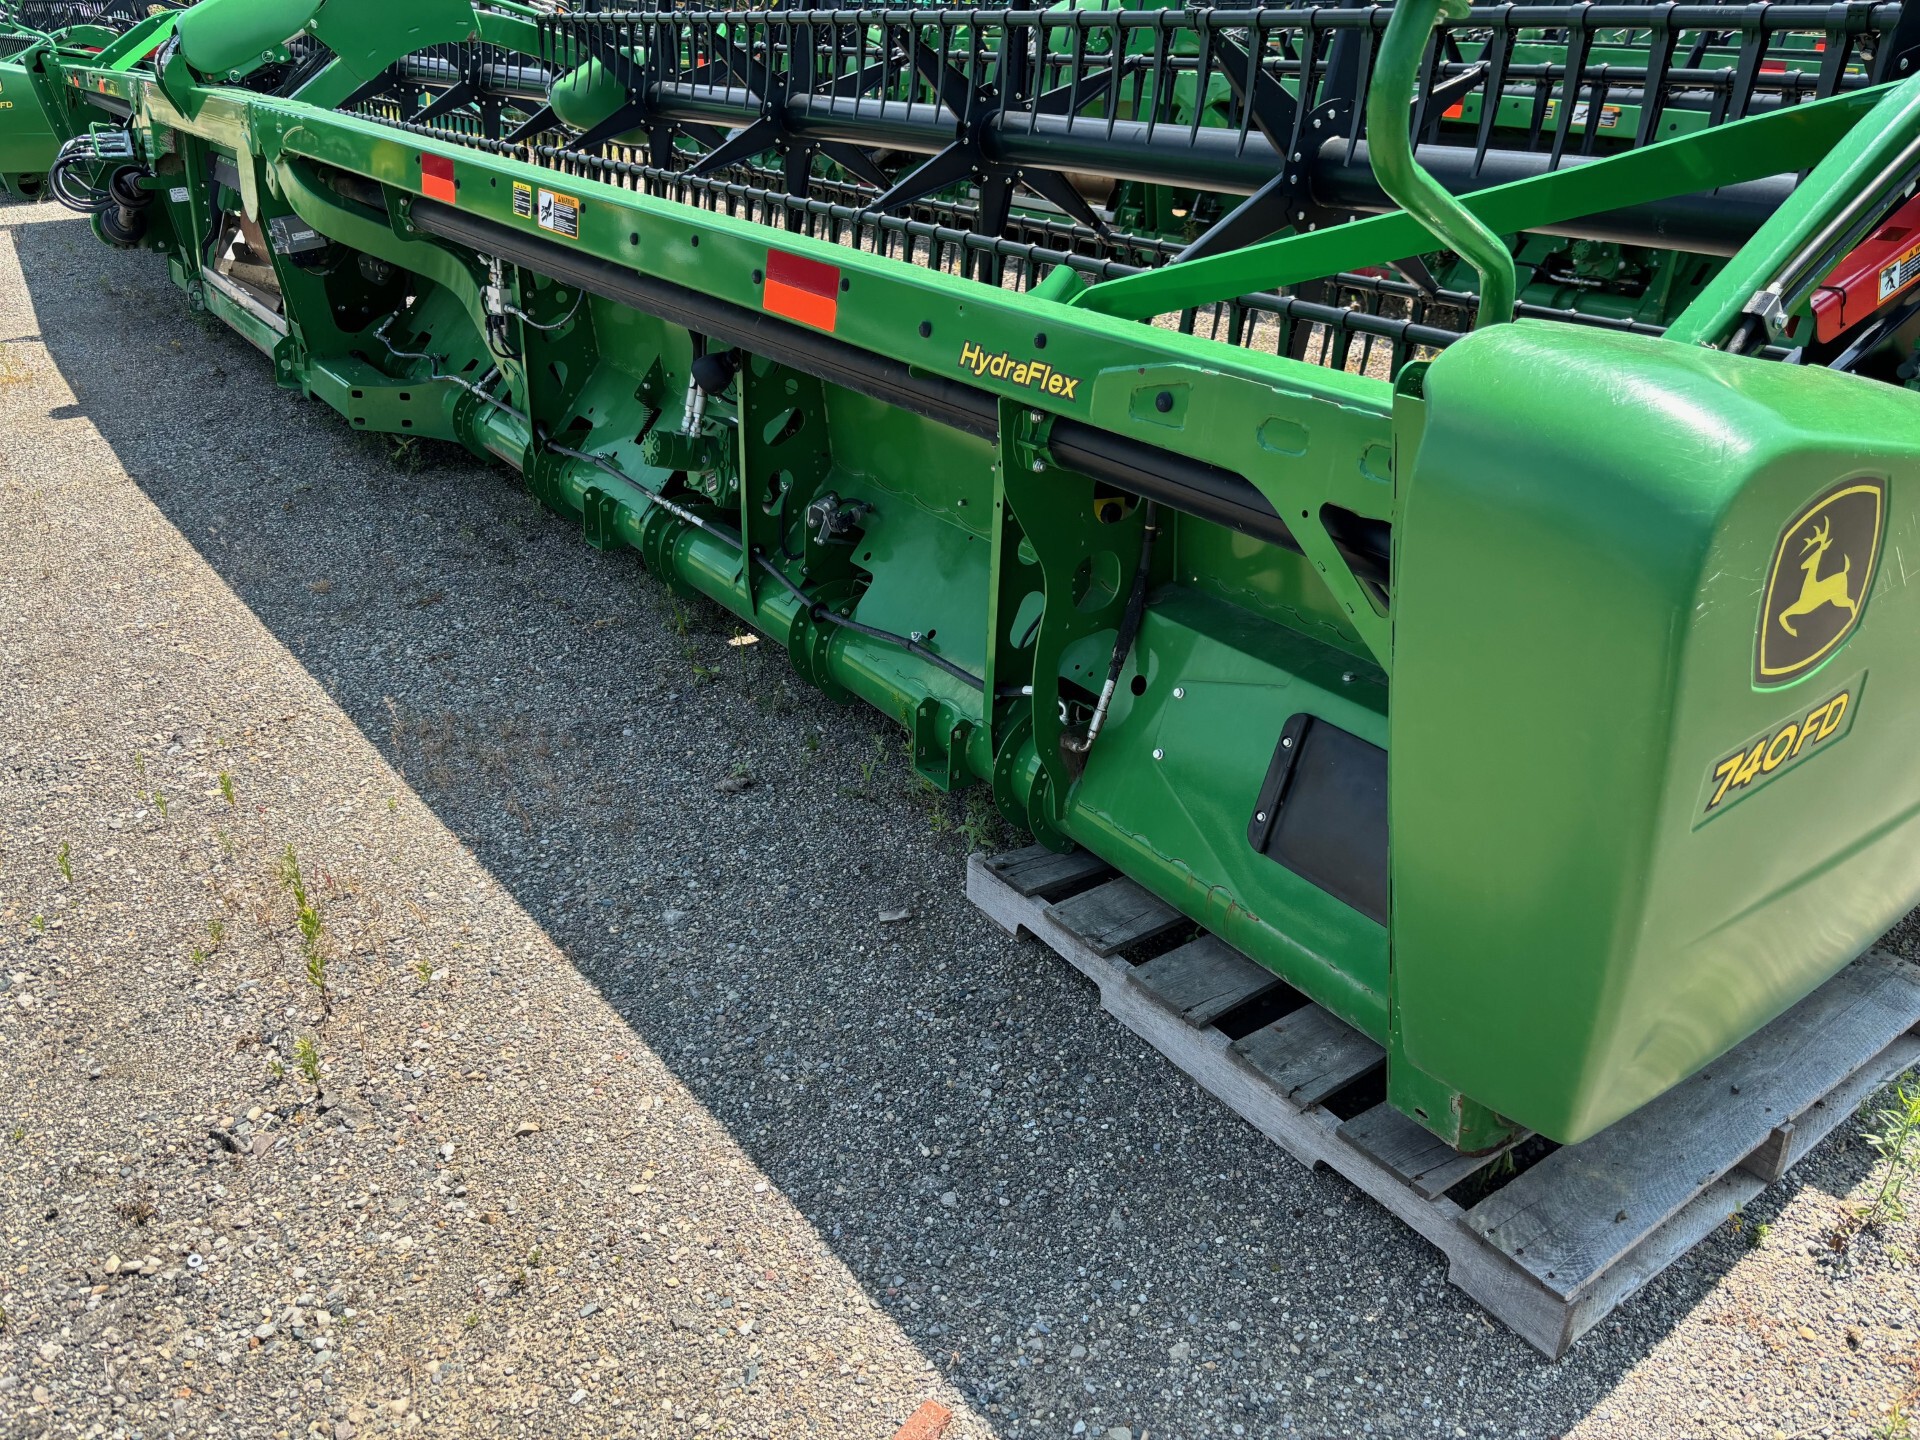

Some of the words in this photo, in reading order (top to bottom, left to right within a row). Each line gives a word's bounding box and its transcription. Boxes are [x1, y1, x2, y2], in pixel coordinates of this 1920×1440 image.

[0, 101, 13, 109] FD
[959, 340, 1081, 401] HydraFlex
[1706, 690, 1849, 811] 740FD
